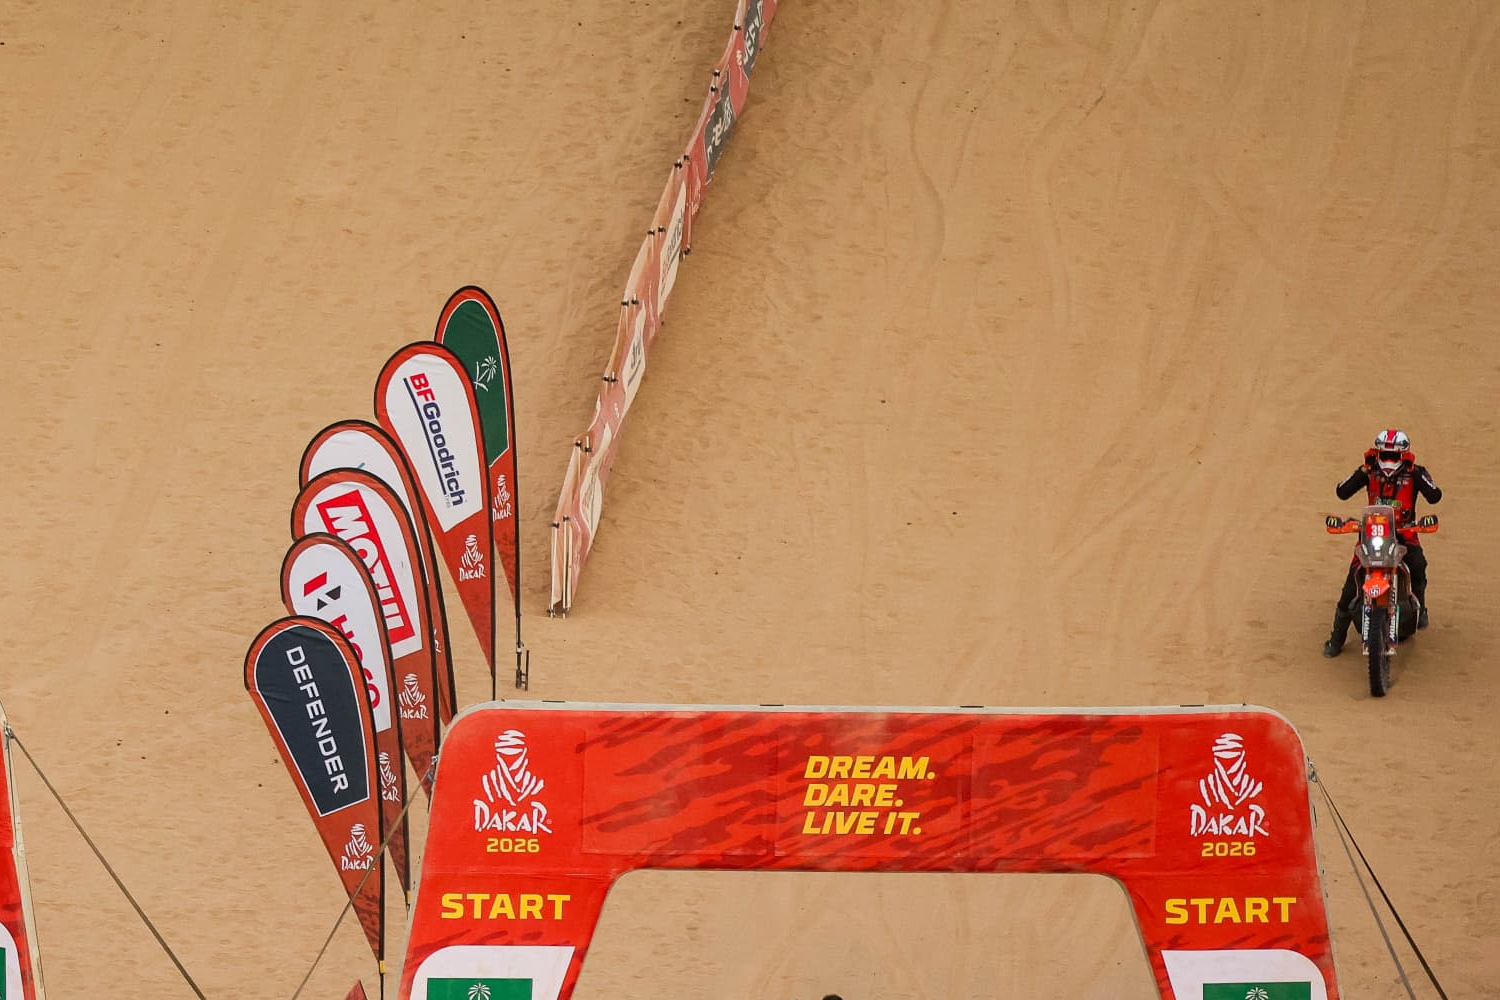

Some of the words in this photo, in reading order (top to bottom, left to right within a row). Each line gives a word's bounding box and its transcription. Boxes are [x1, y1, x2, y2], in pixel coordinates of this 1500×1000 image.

[410, 372, 466, 507] BFGoodrich
[459, 564, 487, 582] DAKAR
[286, 646, 349, 795] DEFENDER
[803, 755, 936, 780] DREAM.
[381, 789, 401, 802] KAR
[803, 783, 904, 807] DARE.
[473, 800, 552, 834] DAKAR
[802, 811, 879, 835] LIVE
[883, 812, 922, 835] IT.
[1190, 804, 1269, 837] DAKAR
[486, 838, 540, 853] 2026
[1201, 842, 1256, 857] 2026
[441, 893, 571, 920] START
[1165, 897, 1297, 925] START
